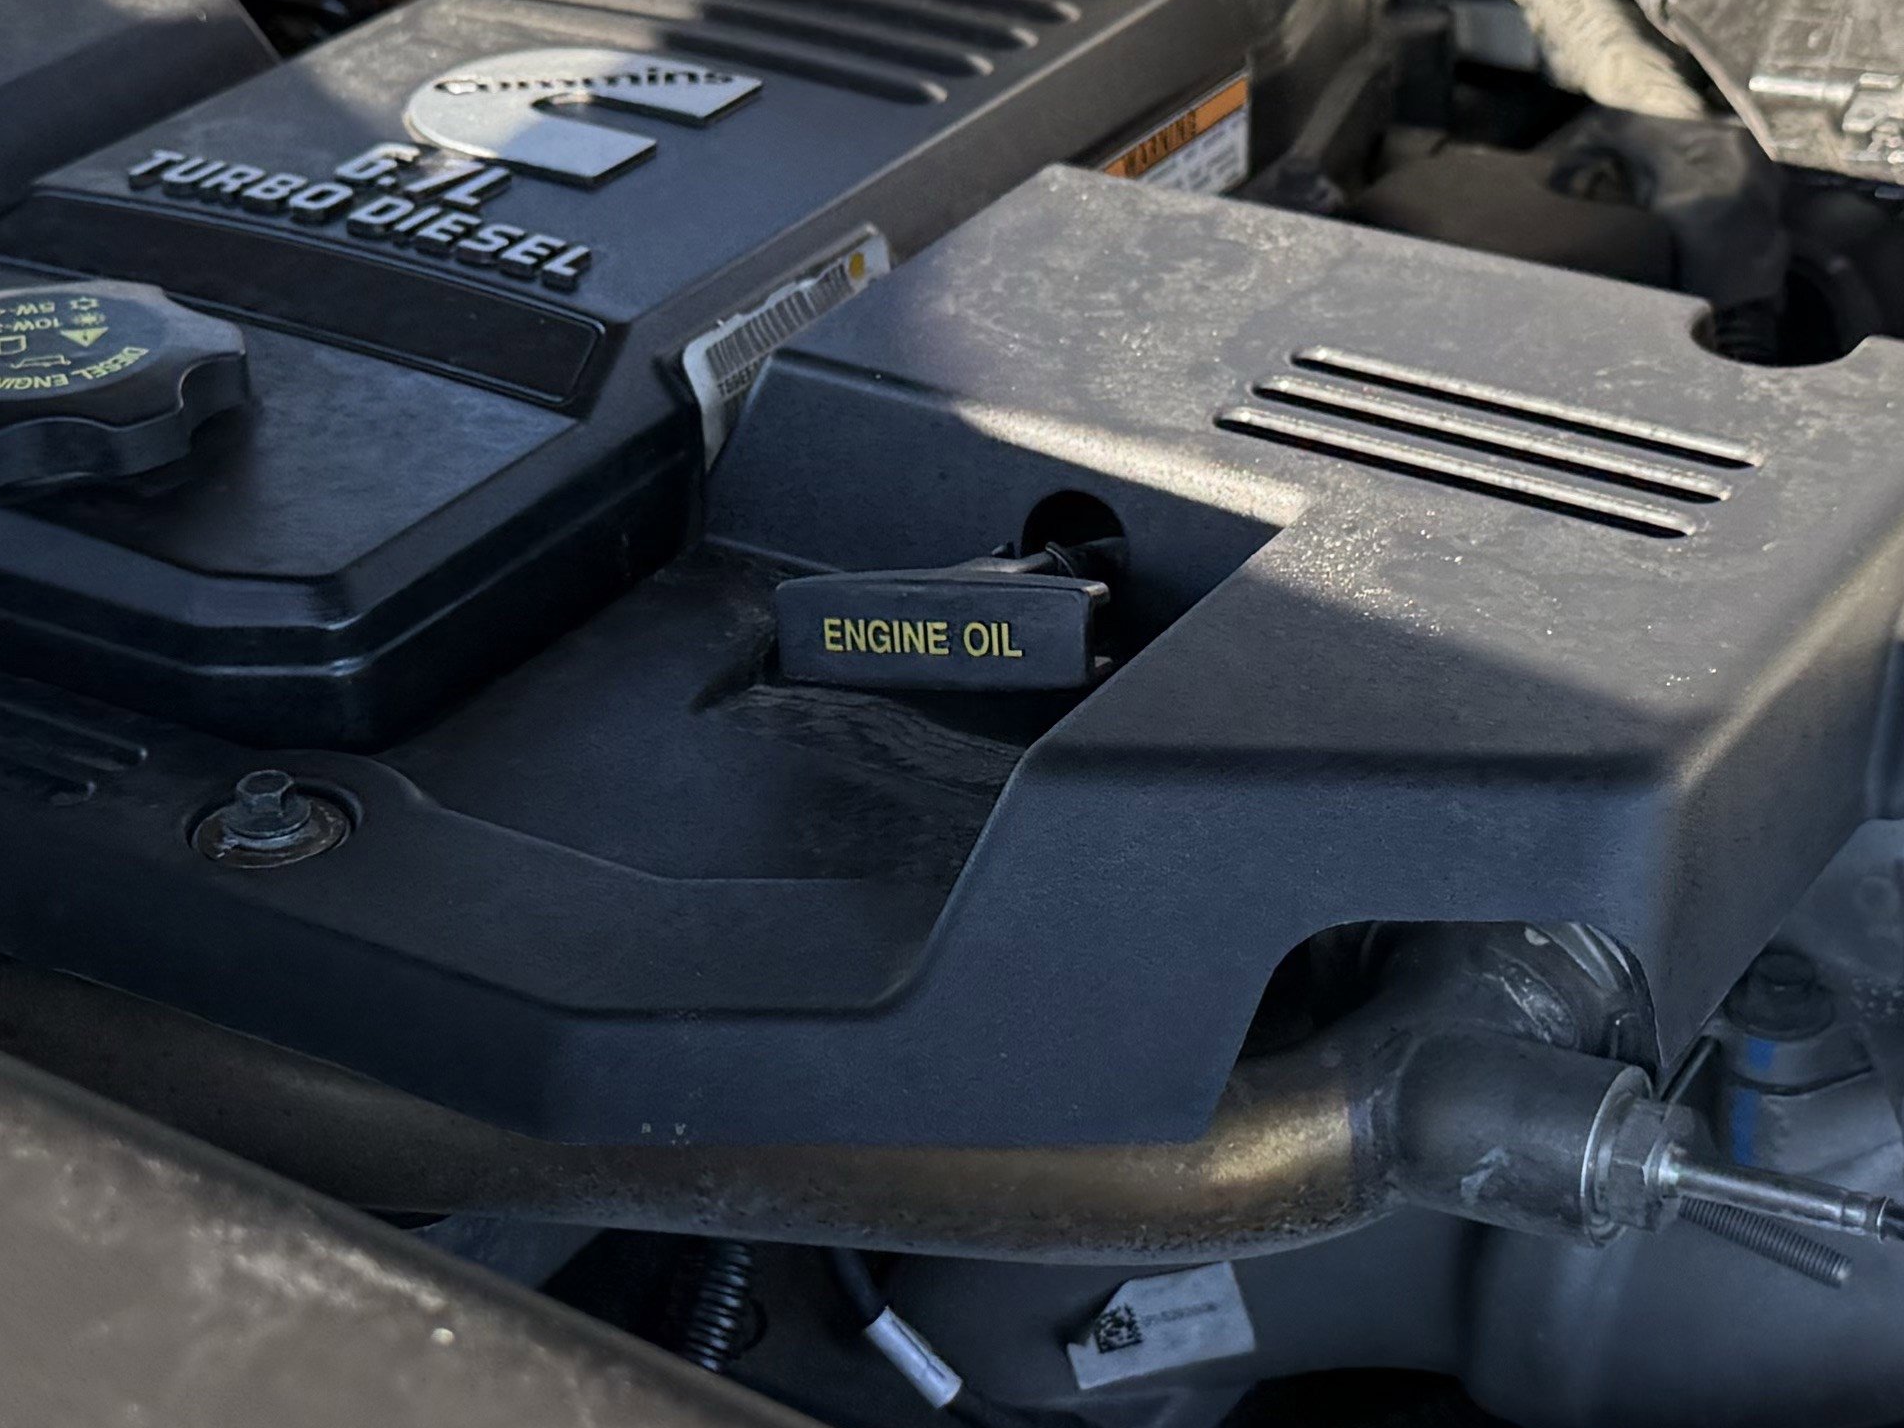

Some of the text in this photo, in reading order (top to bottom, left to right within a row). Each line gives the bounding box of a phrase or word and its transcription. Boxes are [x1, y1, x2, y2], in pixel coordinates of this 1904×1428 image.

[432, 65, 735, 93] Cummins
[336, 141, 512, 211] 6.7L
[130, 150, 595, 284] TURBO DIESEL
[73, 346, 150, 380] DIESEL
[823, 617, 1024, 658] ENGINE OIL
